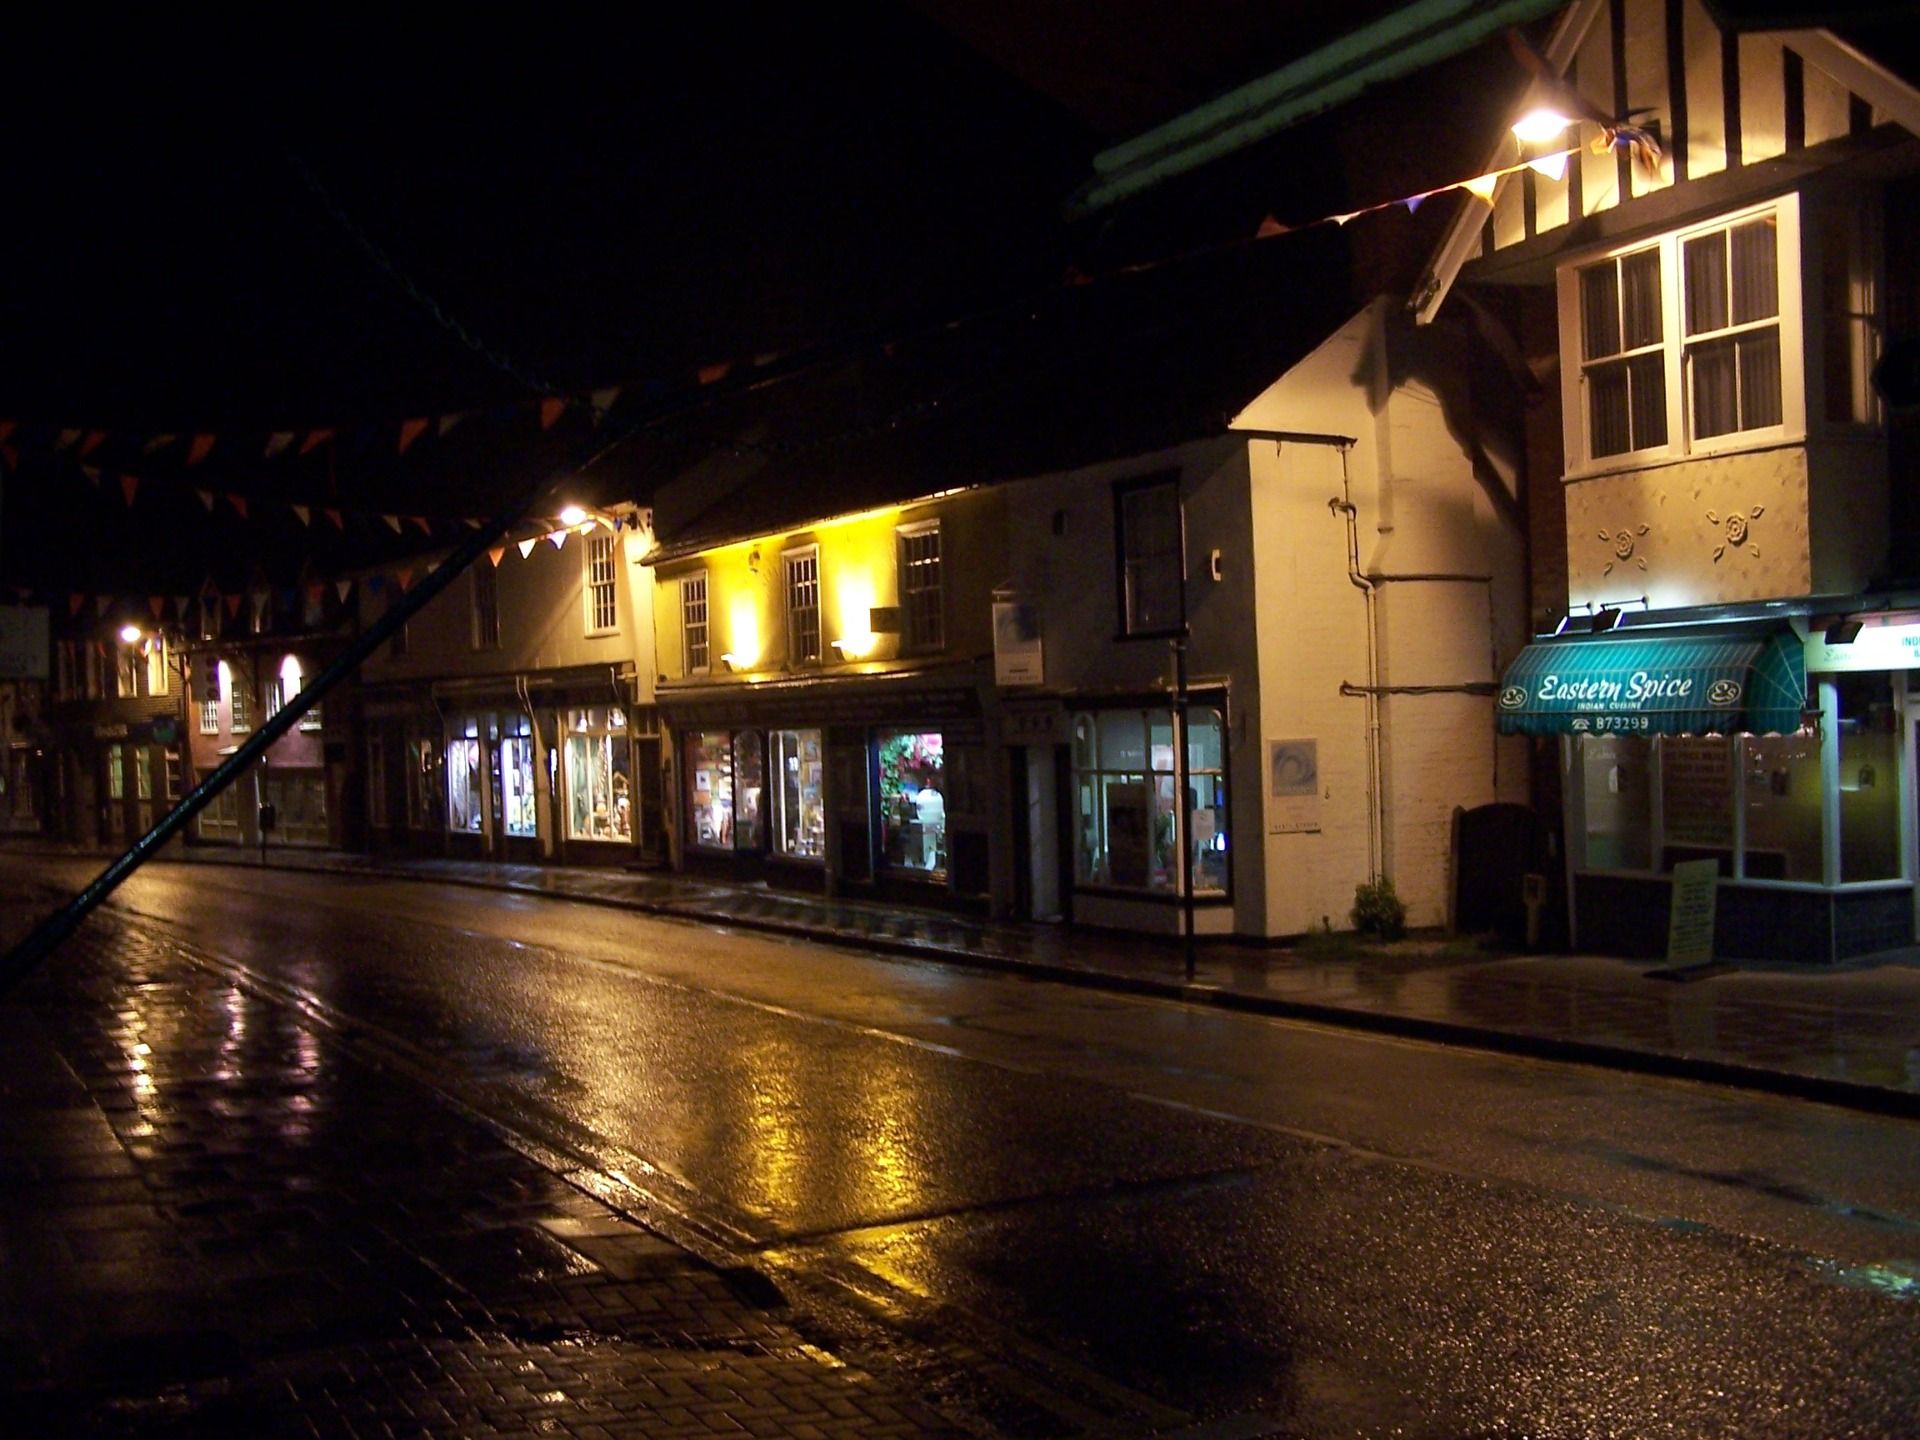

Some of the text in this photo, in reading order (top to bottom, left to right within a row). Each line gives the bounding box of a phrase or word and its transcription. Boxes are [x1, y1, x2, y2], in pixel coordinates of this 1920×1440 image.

[1538, 671, 1693, 701] Eastern Spice
[1577, 702, 1641, 710] INDIAN CUISINE
[1596, 716, 1649, 730] 873299
